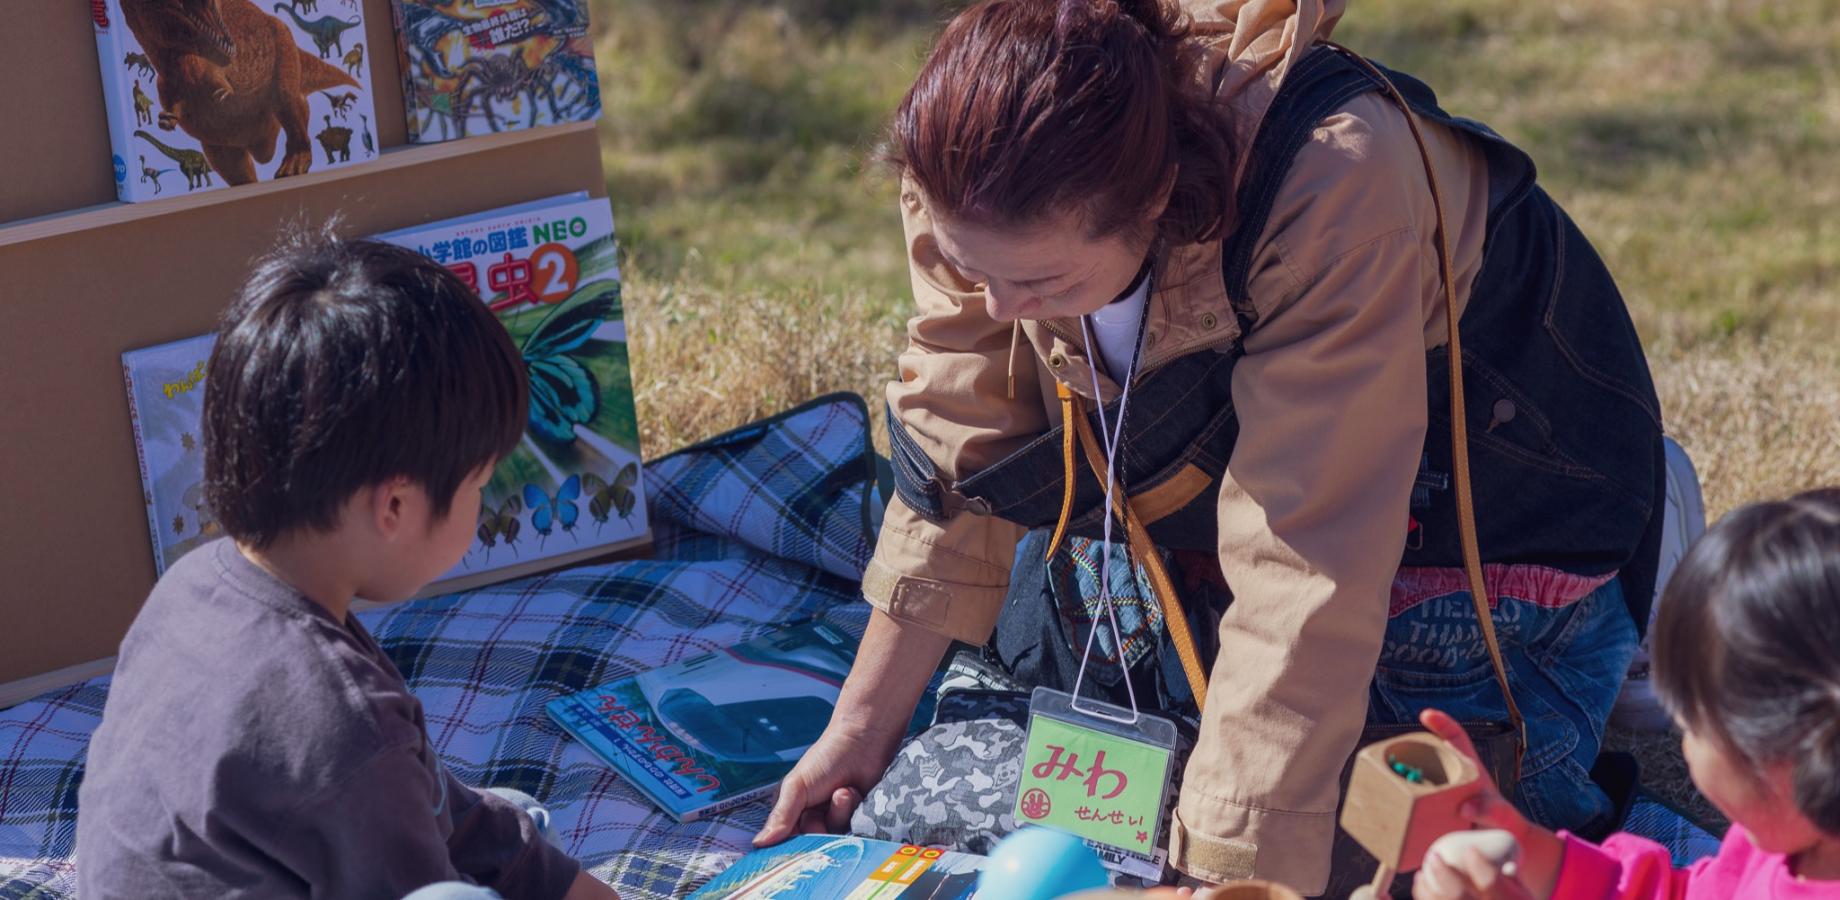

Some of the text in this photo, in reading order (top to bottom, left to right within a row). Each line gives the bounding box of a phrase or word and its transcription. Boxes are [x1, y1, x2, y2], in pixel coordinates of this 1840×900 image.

[532, 216, 587, 245] NEO
[537, 251, 569, 295] 2
[597, 695, 721, 793] しんかんせん
[1032, 744, 1128, 799] みわ
[1074, 806, 1144, 827] せんせい
